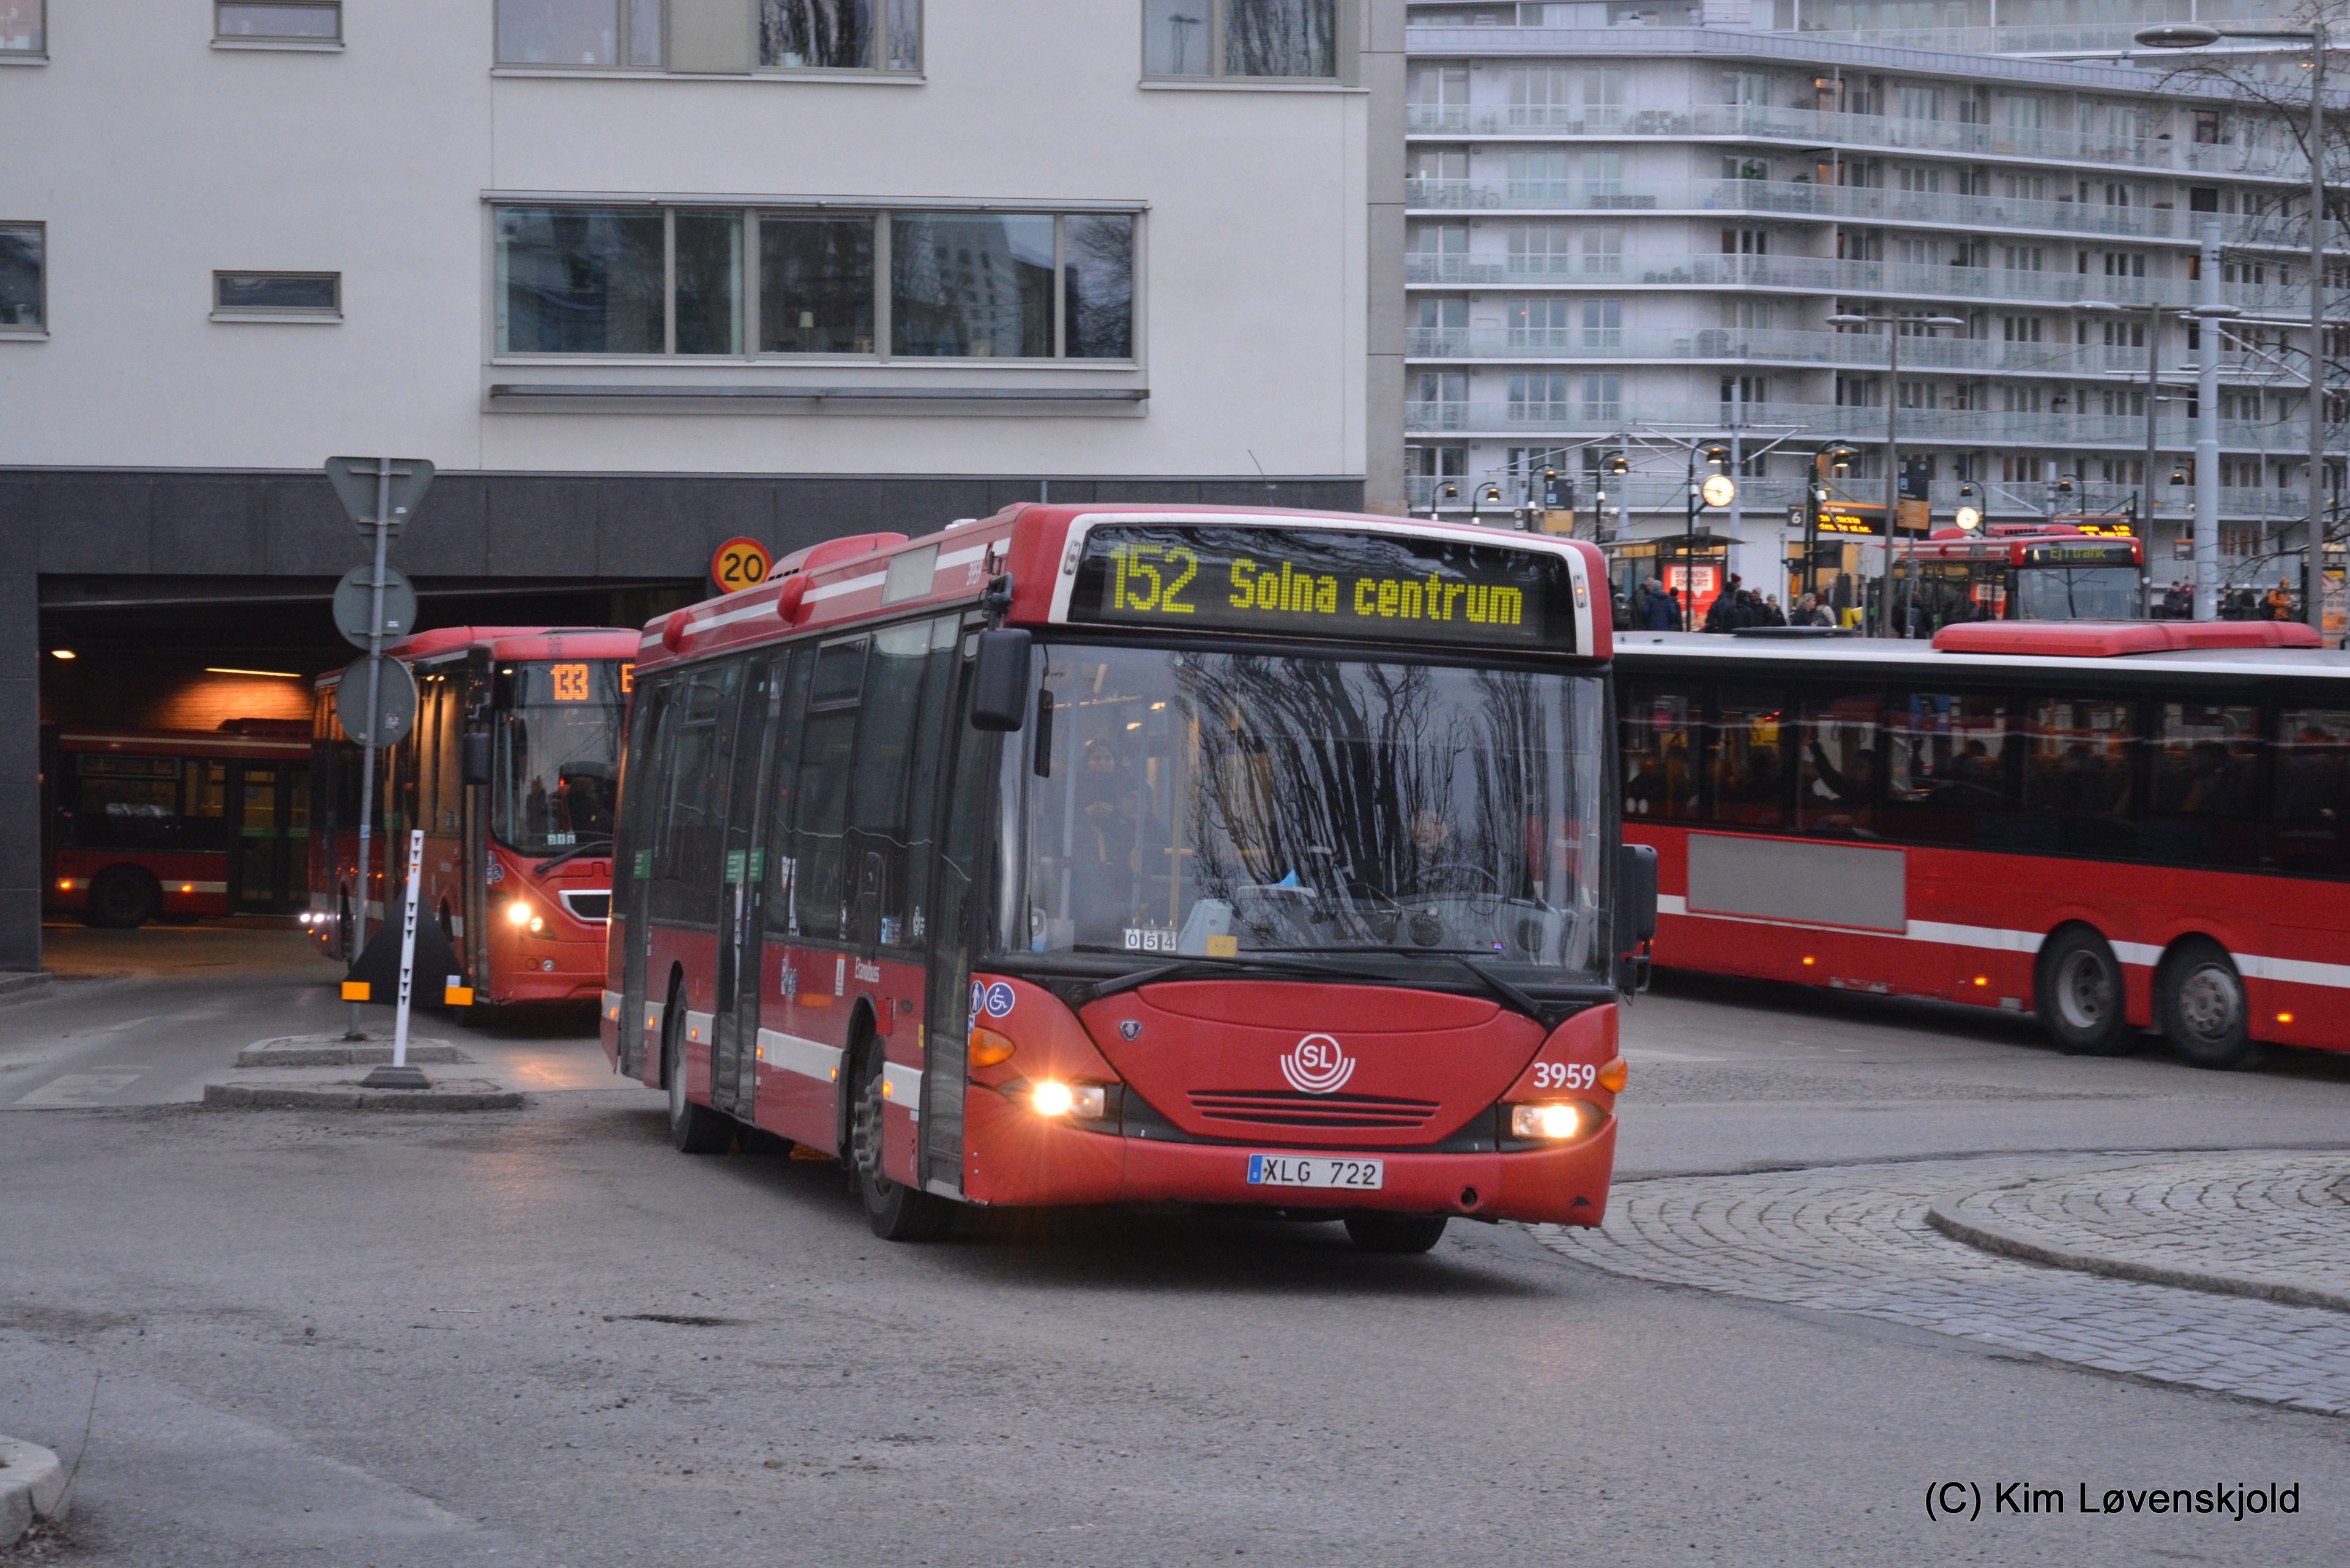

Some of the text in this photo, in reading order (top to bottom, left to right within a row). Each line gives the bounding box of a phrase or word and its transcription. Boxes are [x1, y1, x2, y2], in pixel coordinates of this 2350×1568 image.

[1791, 512, 1802, 524] 6
[724, 553, 763, 583] 20
[1110, 542, 1522, 624] 152 Solna centrum
[550, 663, 588, 700] 133
[1302, 1045, 1333, 1069] SL
[1533, 1062, 1595, 1089] 3959
[1265, 1159, 1311, 1182] XLG
[1330, 1162, 1376, 1185] 722
